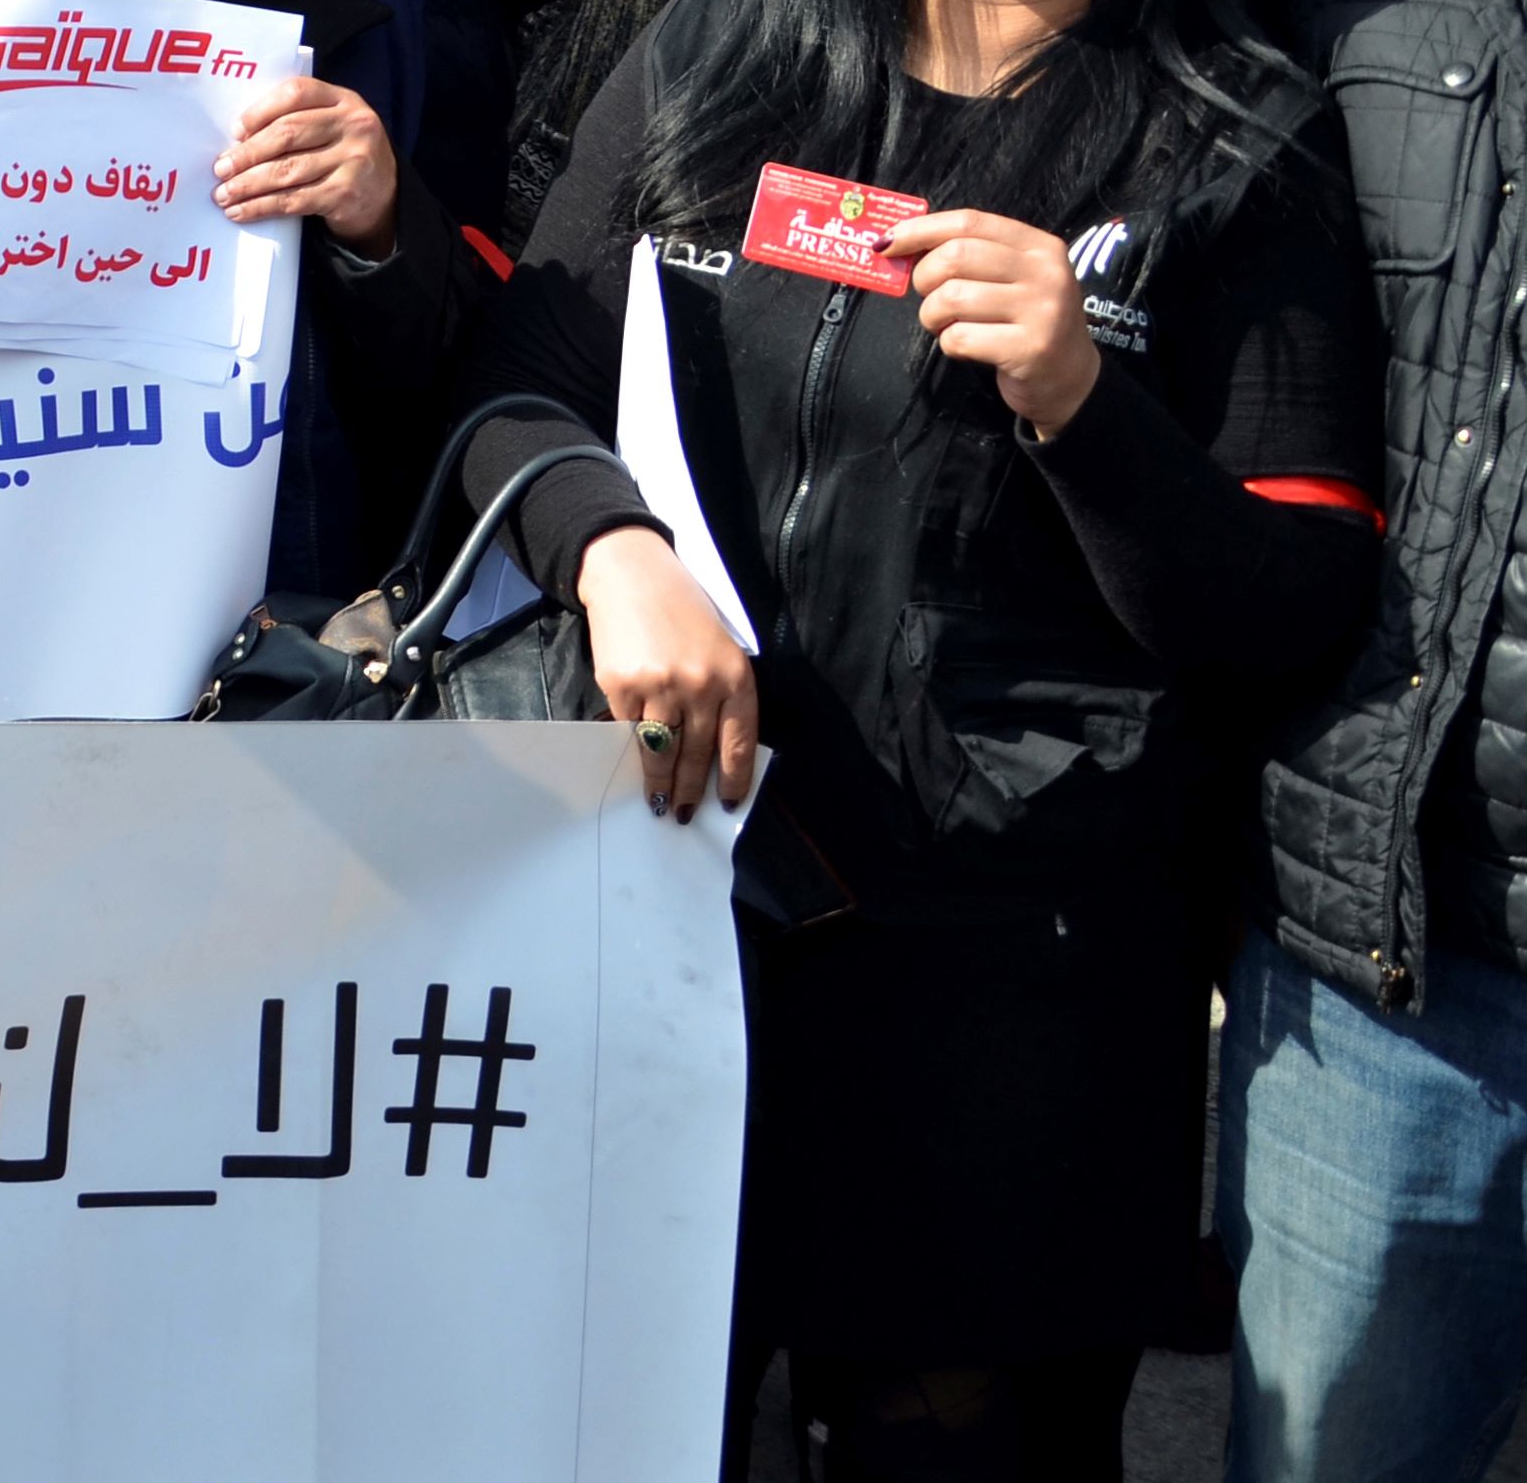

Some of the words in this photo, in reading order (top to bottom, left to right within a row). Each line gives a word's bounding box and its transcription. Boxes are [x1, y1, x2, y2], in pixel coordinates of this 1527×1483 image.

[210, 48, 259, 80] fm
[0, 161, 73, 204] دون
[85, 156, 179, 214] ايقاف
[789, 208, 881, 246] صحافة
[73, 246, 145, 285] حين
[786, 228, 875, 267] PRESSE
[149, 246, 212, 289] الى
